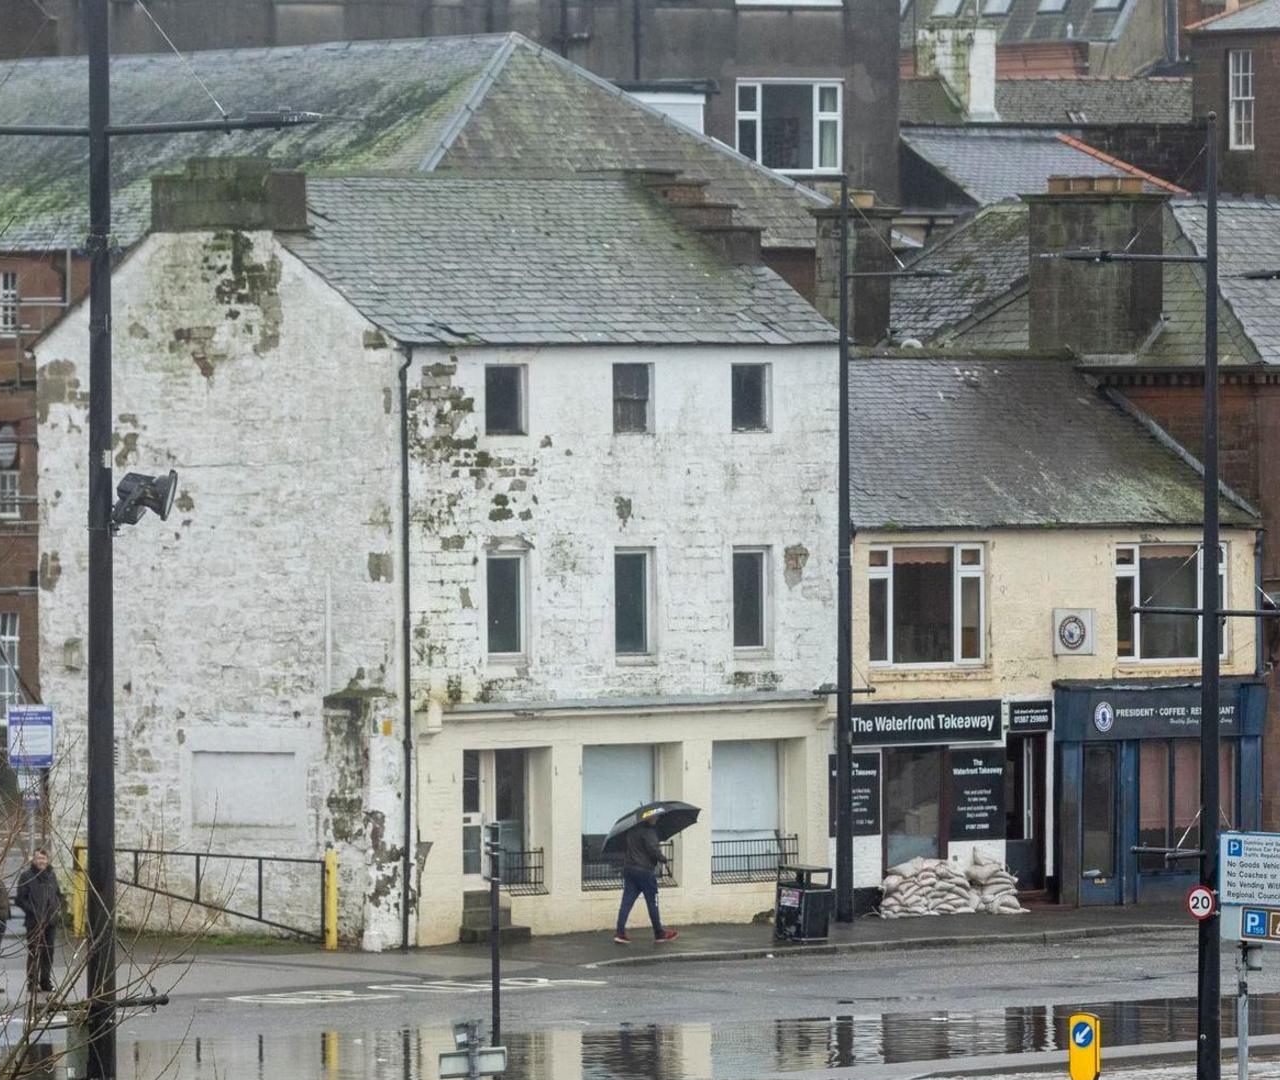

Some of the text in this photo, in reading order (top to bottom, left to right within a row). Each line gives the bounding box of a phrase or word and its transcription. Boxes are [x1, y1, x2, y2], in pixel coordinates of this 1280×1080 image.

[1115, 708, 1154, 717] PRESIDENT
[1159, 707, 1186, 716] COFFEE
[851, 714, 995, 732] The Waterfront Takeaway
[978, 767, 1003, 775] Takeaway
[1227, 860, 1236, 868] No
[1240, 861, 1260, 869] Goods
[1239, 871, 1267, 879] Coaches
[1239, 881, 1265, 890] Vending
[1227, 890, 1255, 899] Regional
[1191, 896, 1210, 909] 20
[1247, 913, 1260, 933] P
